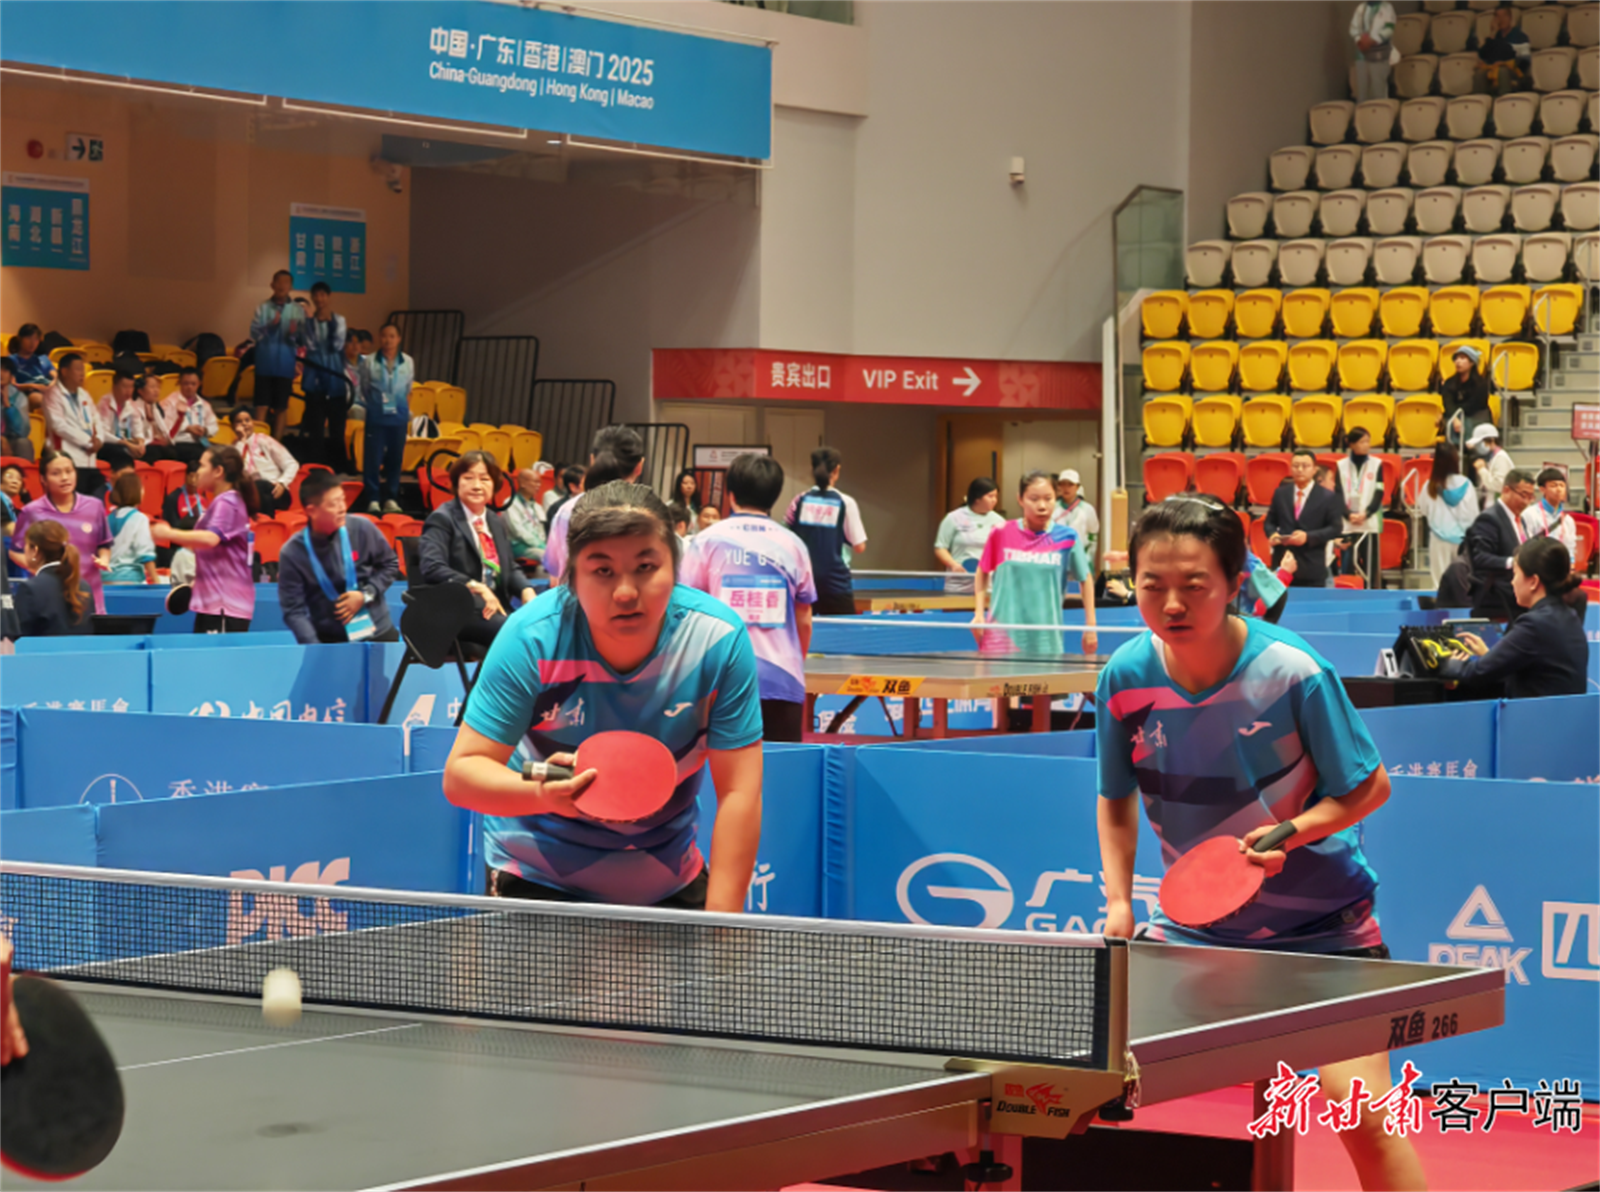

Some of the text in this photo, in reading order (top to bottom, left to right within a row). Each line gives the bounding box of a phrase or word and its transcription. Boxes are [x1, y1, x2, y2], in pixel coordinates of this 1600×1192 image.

[608, 53, 654, 86] 2025
[546, 79, 577, 103] Hong
[579, 83, 608, 107] Kong
[617, 89, 654, 110] Macao
[771, 361, 831, 390] 贵宾出口
[863, 369, 939, 391] VIP Exit
[724, 549, 751, 567] YUE
[1428, 943, 1533, 985] PEAK
[1387, 1010, 1458, 1049] 双鱼 266
